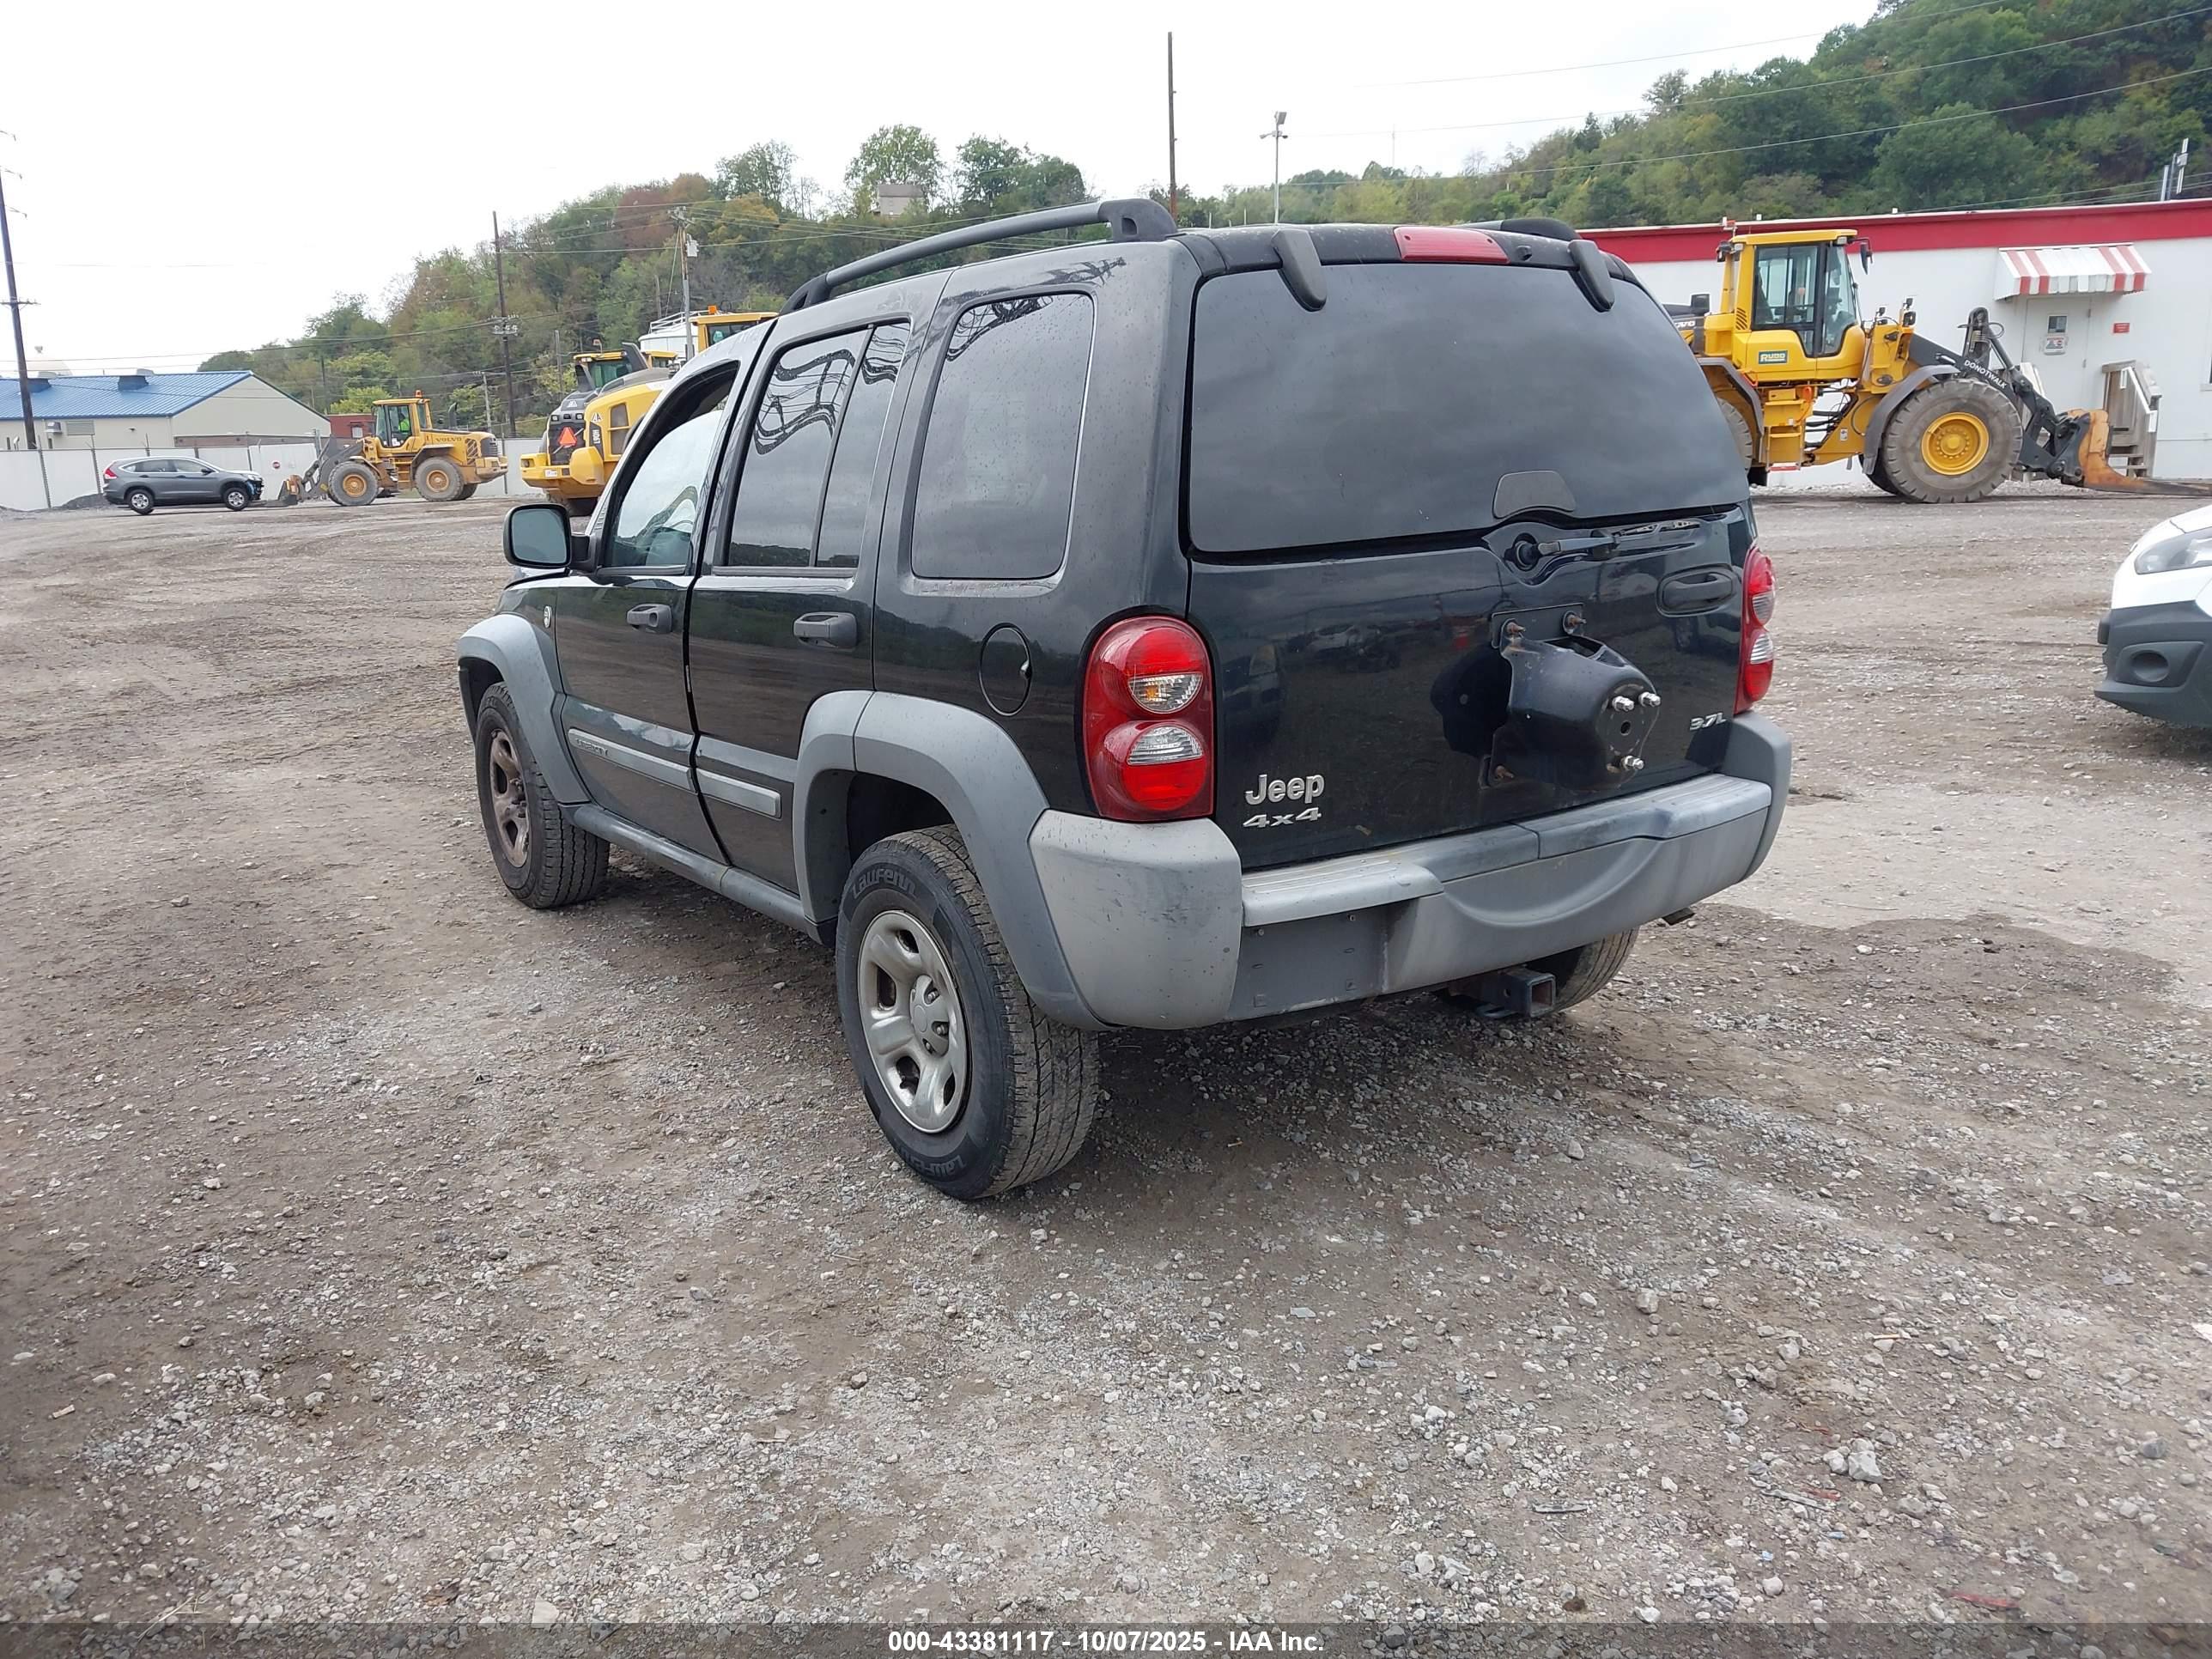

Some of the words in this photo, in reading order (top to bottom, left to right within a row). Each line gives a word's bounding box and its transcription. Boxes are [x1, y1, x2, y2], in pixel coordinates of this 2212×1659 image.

[1689, 712, 1727, 731] 3.7L
[1244, 774, 1325, 805] Jeep
[1242, 807, 1322, 829] 4x4
